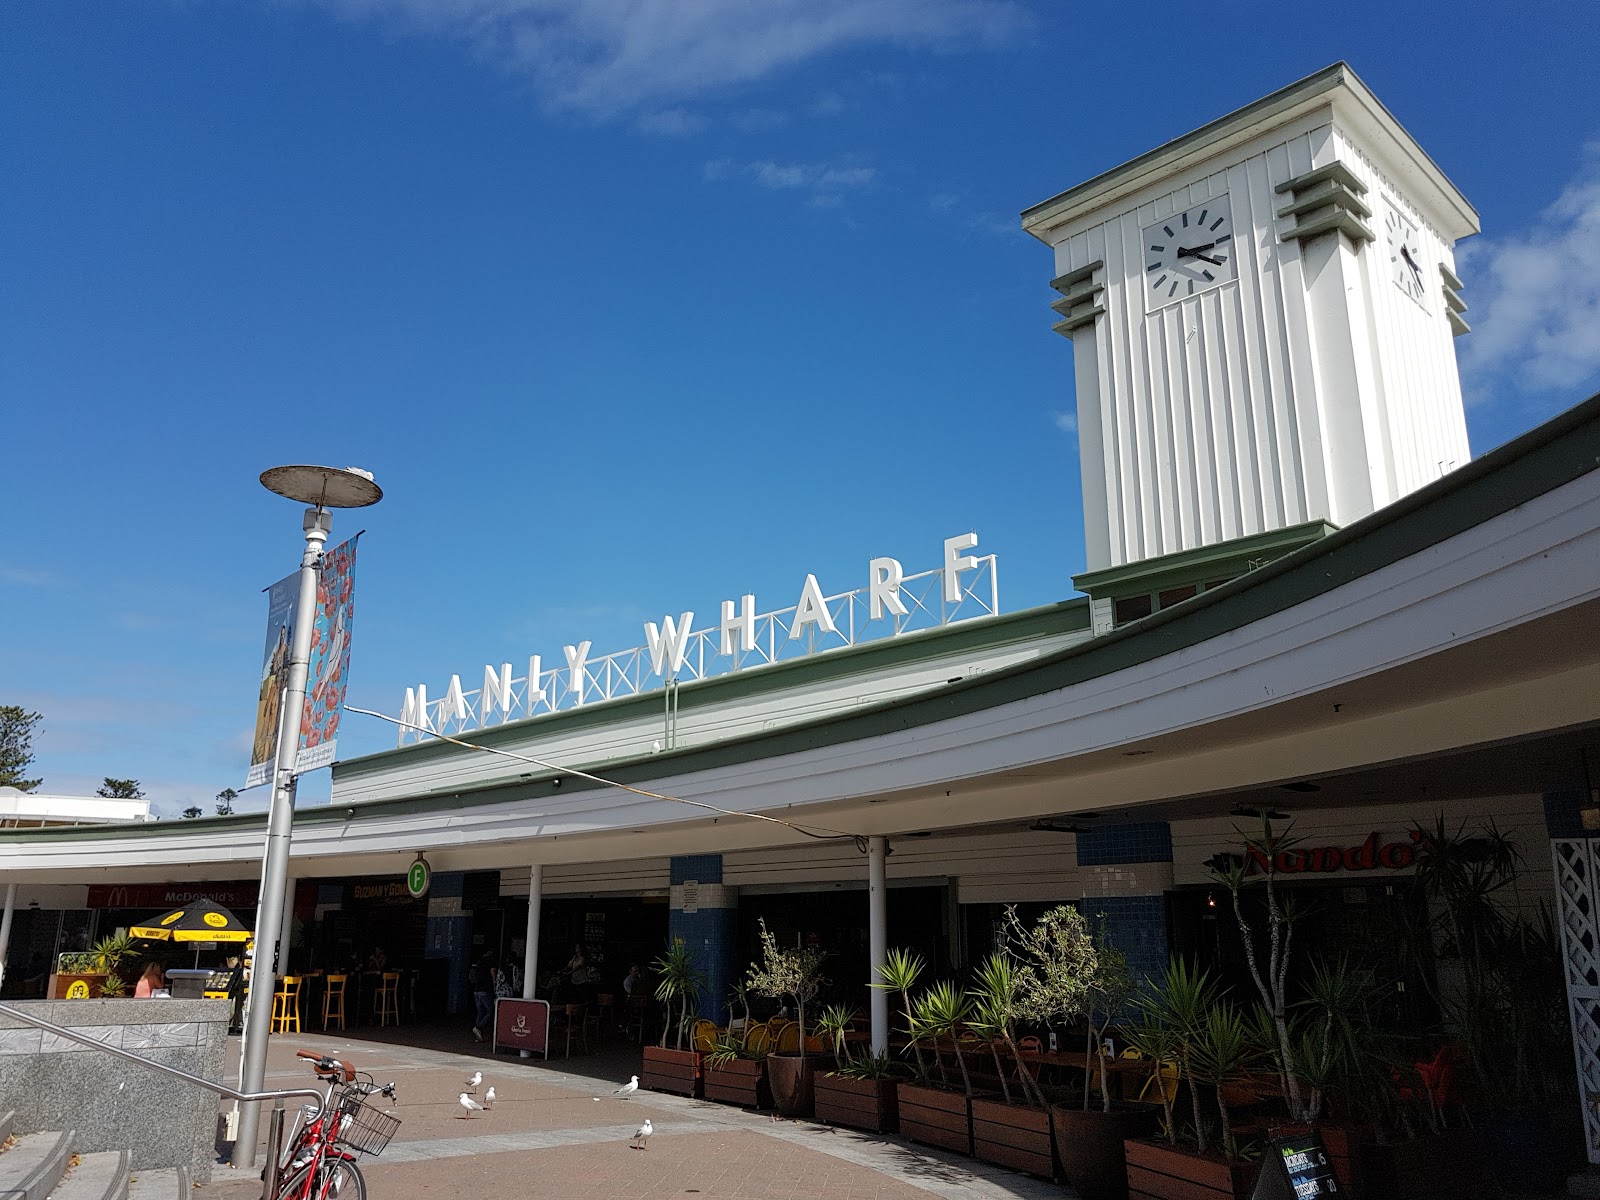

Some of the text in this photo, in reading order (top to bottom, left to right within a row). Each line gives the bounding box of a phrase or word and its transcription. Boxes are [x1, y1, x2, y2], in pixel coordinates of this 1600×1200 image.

[401, 532, 978, 733] MANLY WHARF
[414, 869, 421, 888] F
